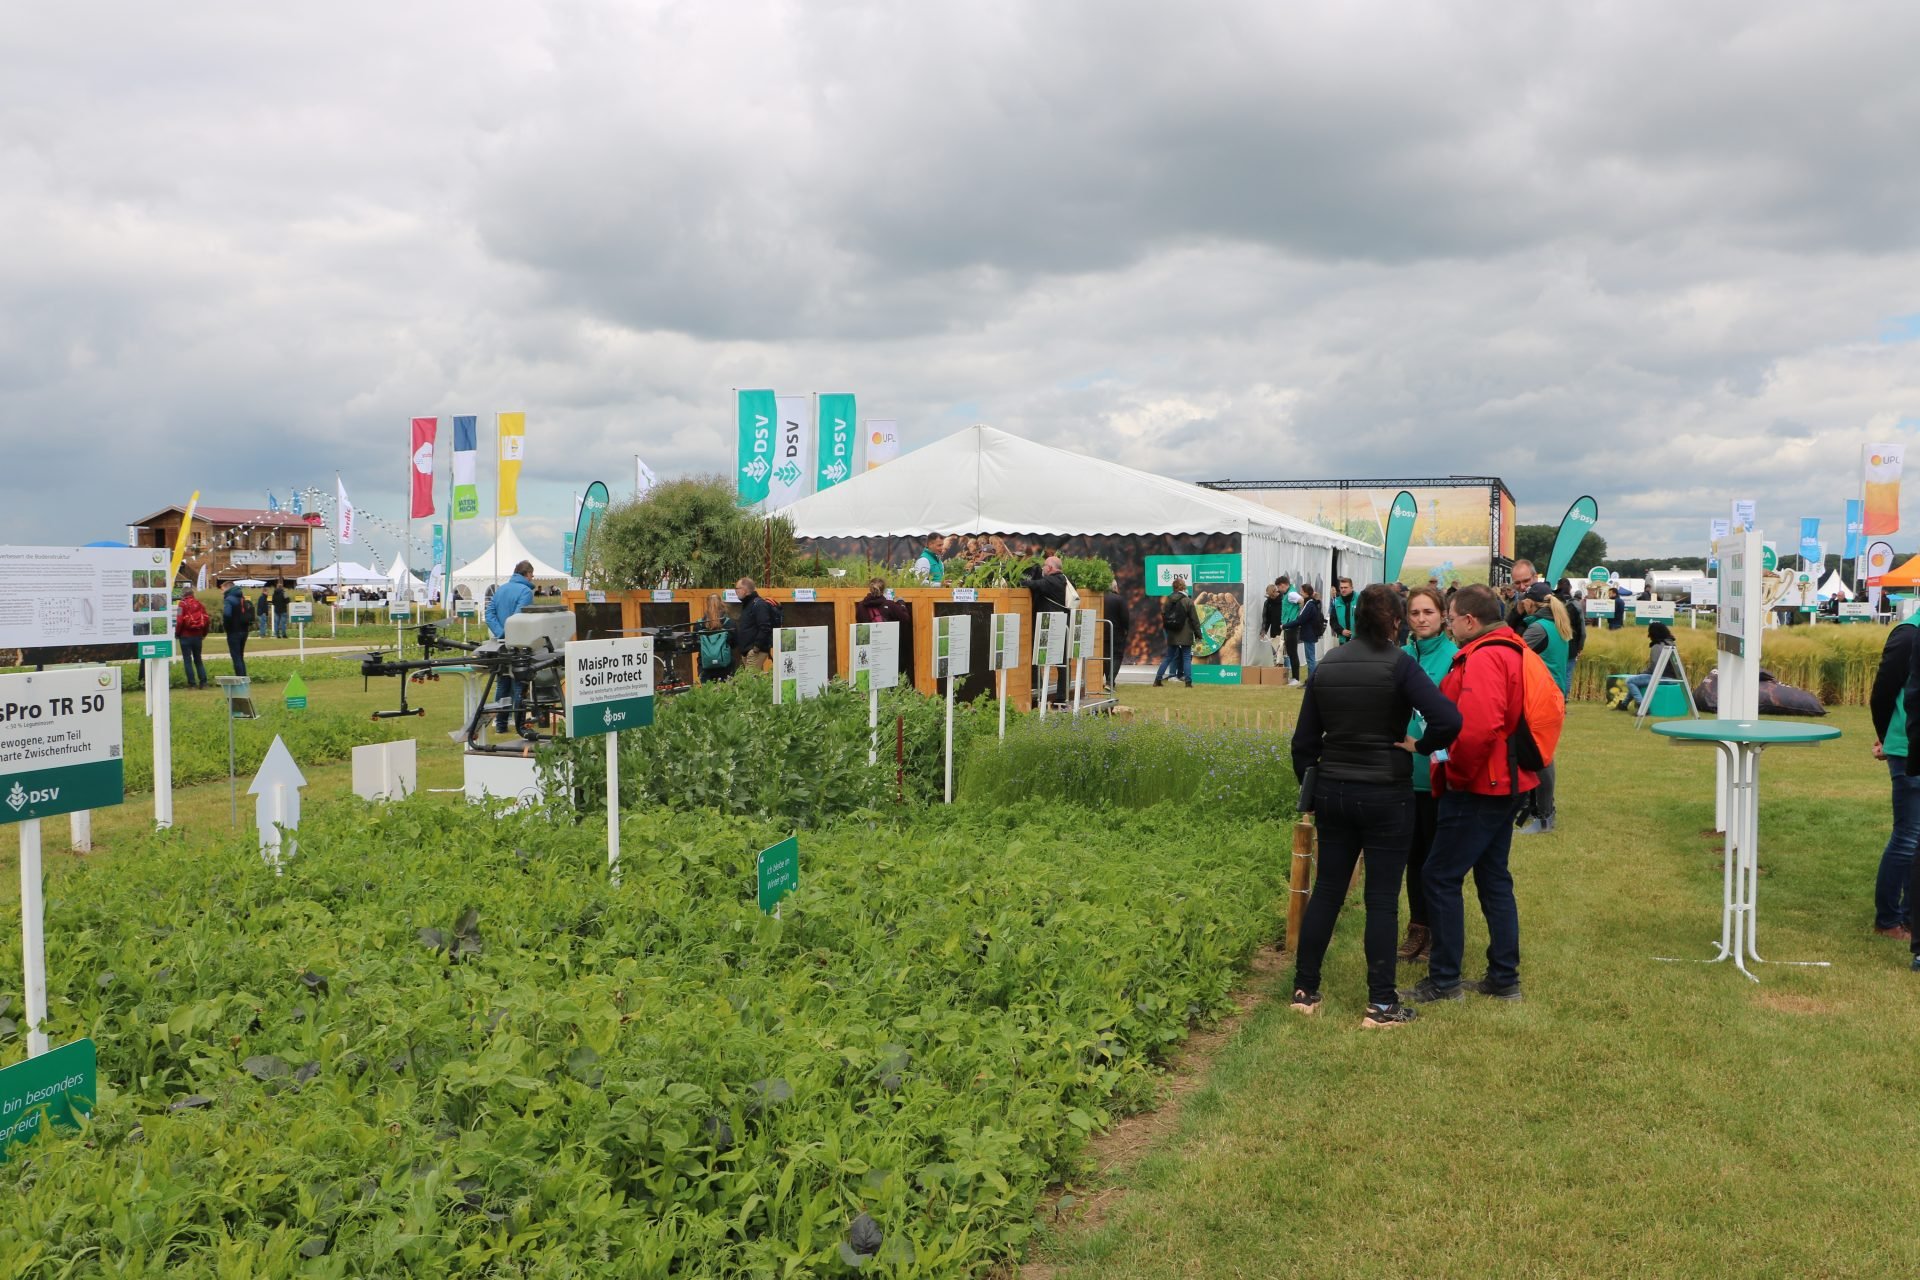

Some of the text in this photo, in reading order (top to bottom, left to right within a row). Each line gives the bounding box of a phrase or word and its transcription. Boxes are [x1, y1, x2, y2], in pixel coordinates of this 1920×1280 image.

[753, 414, 769, 453] DSV
[786, 420, 799, 458] DSV
[834, 418, 847, 456] DSV
[1882, 456, 1900, 464] UPL
[342, 506, 352, 539] Nordic
[1401, 510, 1416, 518] DSV
[1580, 515, 1595, 525] DSV
[578, 652, 648, 672] MaisPro TR 50
[585, 671, 604, 687] Soil
[607, 669, 642, 684] Protect
[49, 697, 74, 717] TR
[81, 694, 105, 714] 50
[612, 711, 626, 722] DSV
[47, 733, 65, 744] zum
[67, 729, 81, 741] Teil
[25, 741, 92, 760] Zwischenfrucht
[30, 787, 60, 804] DSV
[3, 1073, 84, 1116] bin besonders
